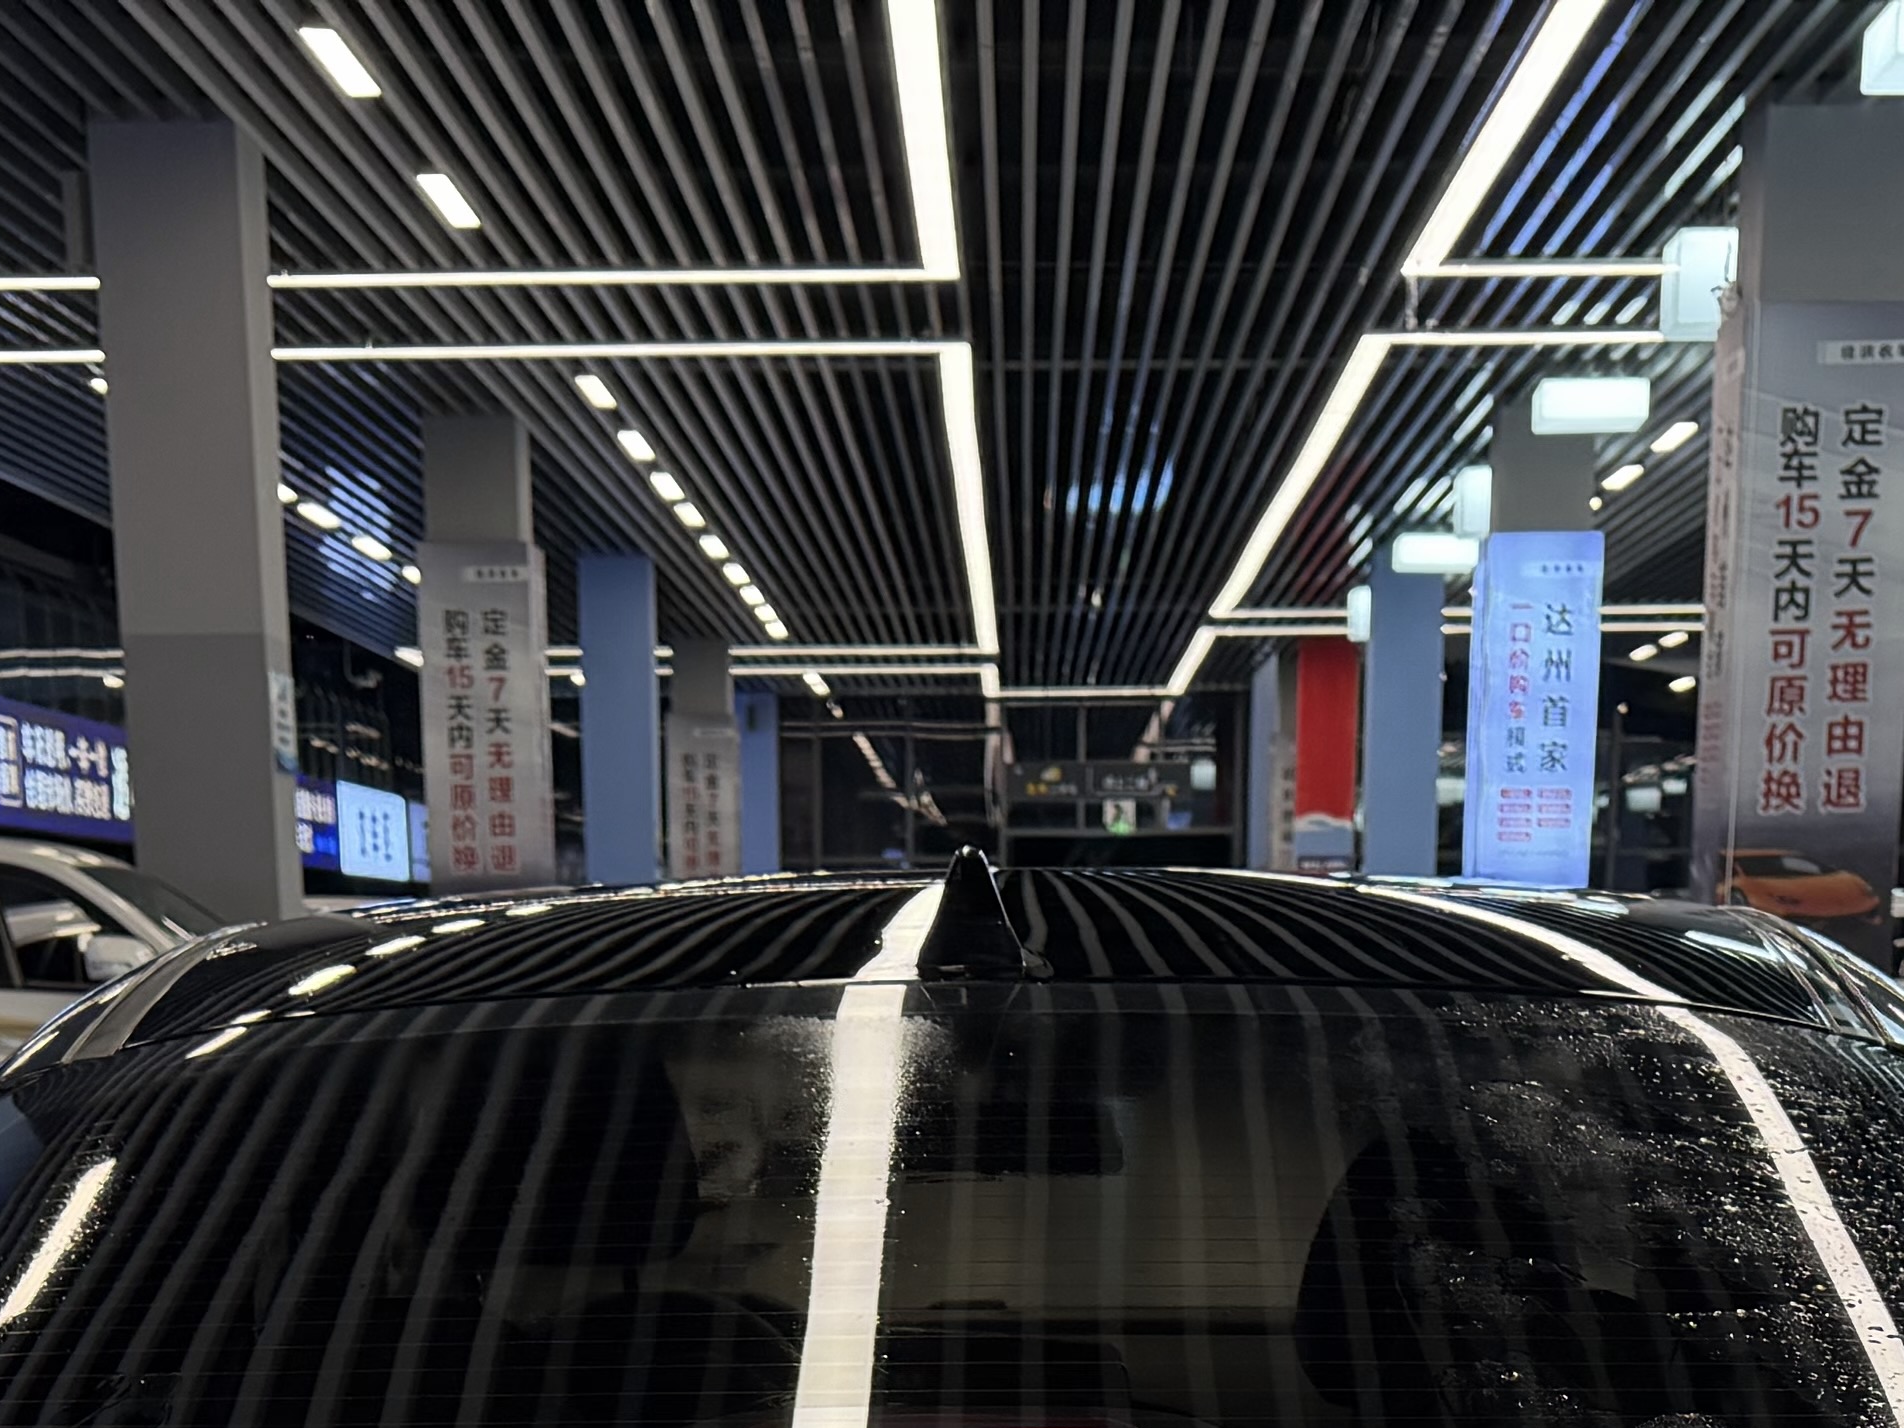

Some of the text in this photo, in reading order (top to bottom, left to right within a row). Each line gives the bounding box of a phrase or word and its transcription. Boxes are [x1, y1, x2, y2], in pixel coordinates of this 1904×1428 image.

[443, 607, 479, 874] 购车15天内可原价换
[480, 607, 522, 875] 定金7天无理由退
[1536, 602, 1575, 774] 达州首家
[1760, 403, 1823, 815] 购车15天内可原价换
[1820, 402, 1887, 814] 定金7天无理由退
